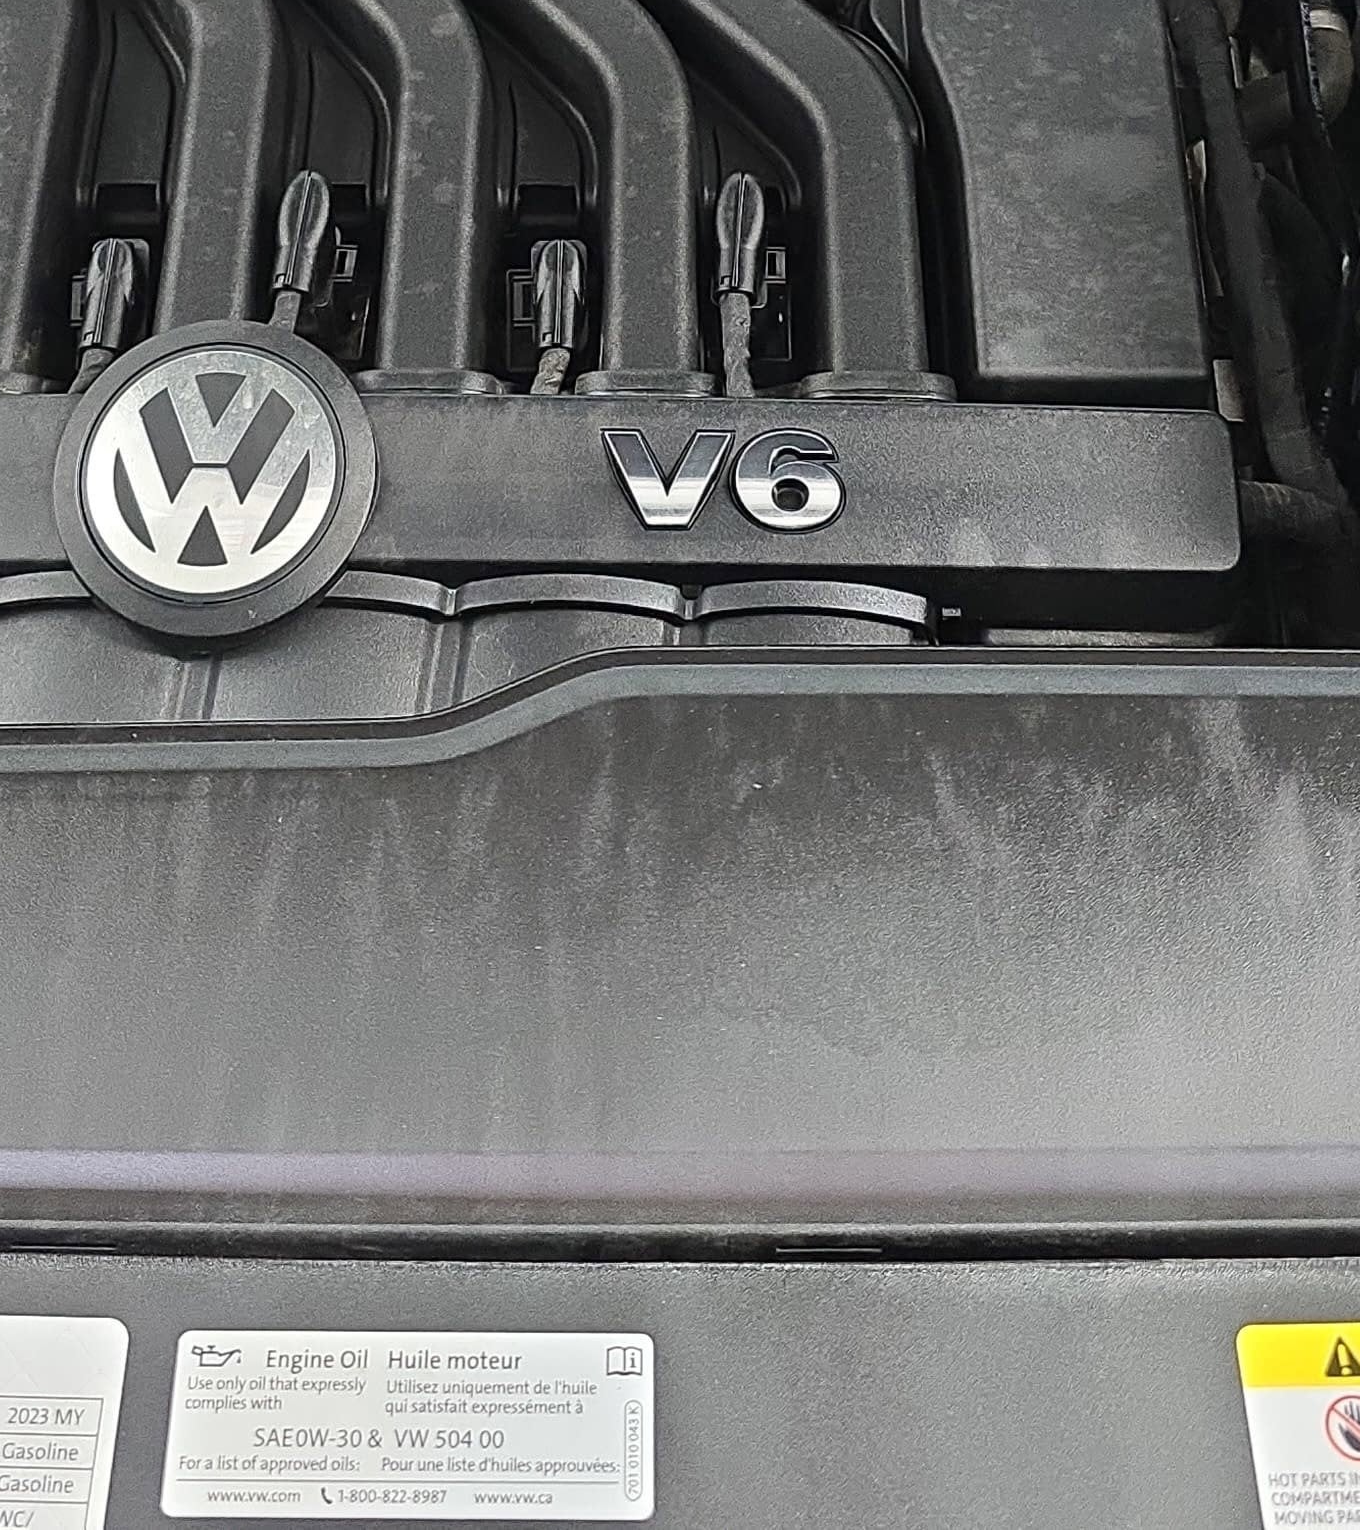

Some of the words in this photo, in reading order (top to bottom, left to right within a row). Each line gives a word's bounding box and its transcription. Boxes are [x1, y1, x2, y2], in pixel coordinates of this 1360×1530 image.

[600, 427, 847, 535] V6
[266, 1349, 335, 1374] Engine
[340, 1349, 369, 1369] Oil
[388, 1350, 441, 1369] Huile
[447, 1351, 522, 1369] moteur
[187, 1376, 214, 1391] Use
[216, 1377, 247, 1394] only
[249, 1377, 266, 1391] oil
[269, 1377, 298, 1391] that
[301, 1378, 367, 1396] expressly
[386, 1380, 439, 1395] Utilisez
[442, 1381, 530, 1398] uniquement
[533, 1381, 551, 1395] de
[554, 1381, 597, 1395] l'huile
[185, 1396, 248, 1413] complies
[250, 1395, 283, 1410] with
[384, 1399, 408, 1417] qui
[412, 1398, 468, 1413] satisfait
[471, 1399, 572, 1418] expressément
[574, 1399, 584, 1414] à
[628, 1405, 639, 1415] K
[8, 1407, 50, 1425] 2023
[54, 1408, 86, 1425] MY
[367, 1429, 383, 1448] &
[394, 1428, 430, 1449] VW
[435, 1429, 473, 1449] 504
[479, 1429, 505, 1449] 00
[628, 1418, 639, 1441] 043
[2, 1442, 79, 1461] Gasoline
[628, 1445, 639, 1469] 010
[179, 1455, 201, 1470] For
[205, 1458, 213, 1471] a
[217, 1455, 238, 1471] list
[242, 1455, 259, 1471] of
[260, 1456, 328, 1475] approved
[331, 1456, 361, 1472] oils:
[382, 1456, 414, 1471] Pour
[417, 1459, 443, 1472] une
[447, 1457, 476, 1472] liste
[479, 1457, 532, 1473] d'huiles
[535, 1458, 621, 1476] approuvées:
[628, 1473, 639, 1495] 701
[1269, 1472, 1297, 1488] HOT
[1301, 1472, 1346, 1487] PARTS
[207, 1490, 301, 1503] www.vw.com
[338, 1488, 447, 1504] 1-800-822-8987
[474, 1491, 553, 1505] www.vw.ca
[1274, 1509, 1334, 1526] MOVING
